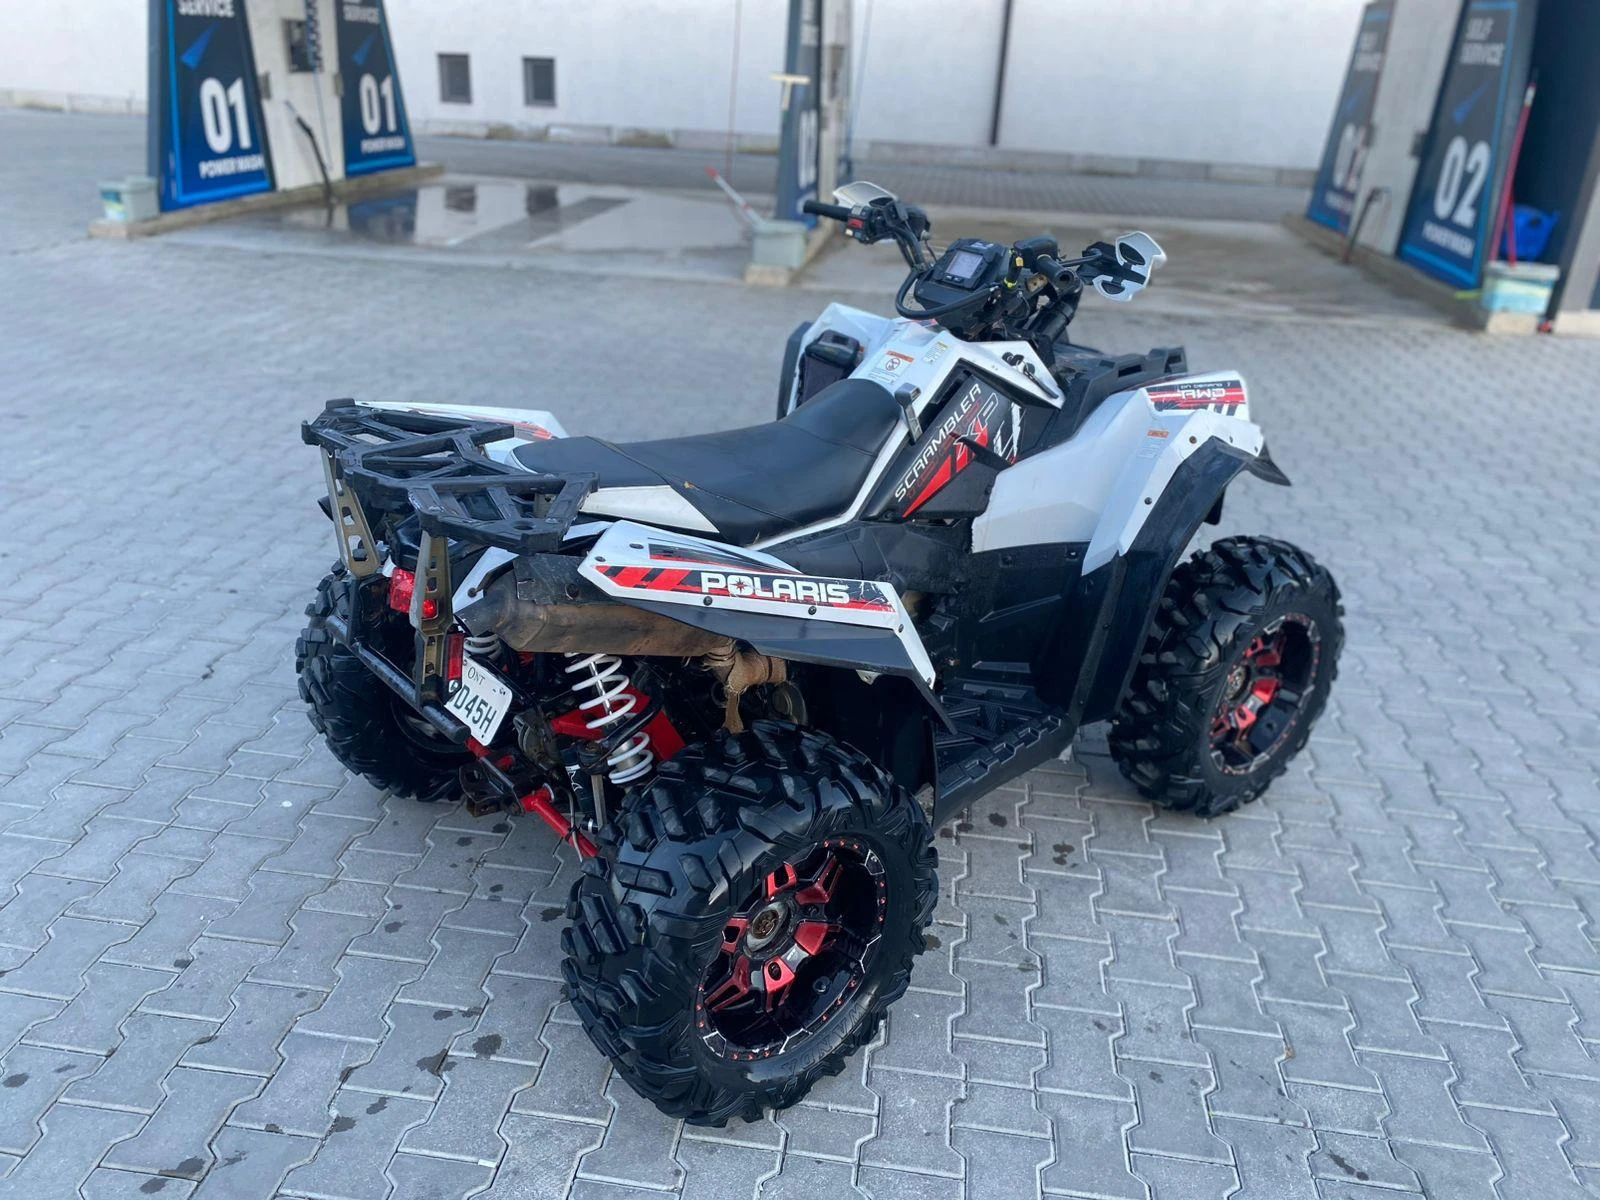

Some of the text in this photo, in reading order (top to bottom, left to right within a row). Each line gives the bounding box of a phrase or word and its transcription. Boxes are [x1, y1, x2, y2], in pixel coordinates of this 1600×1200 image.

[200, 77, 251, 153] 01
[359, 73, 396, 134] 01
[1434, 136, 1491, 228] 02
[894, 383, 981, 502] SCRAMBLER
[952, 392, 999, 461] XP
[701, 572, 850, 604] POLARIS
[780, 1000, 868, 1077] WANDA
